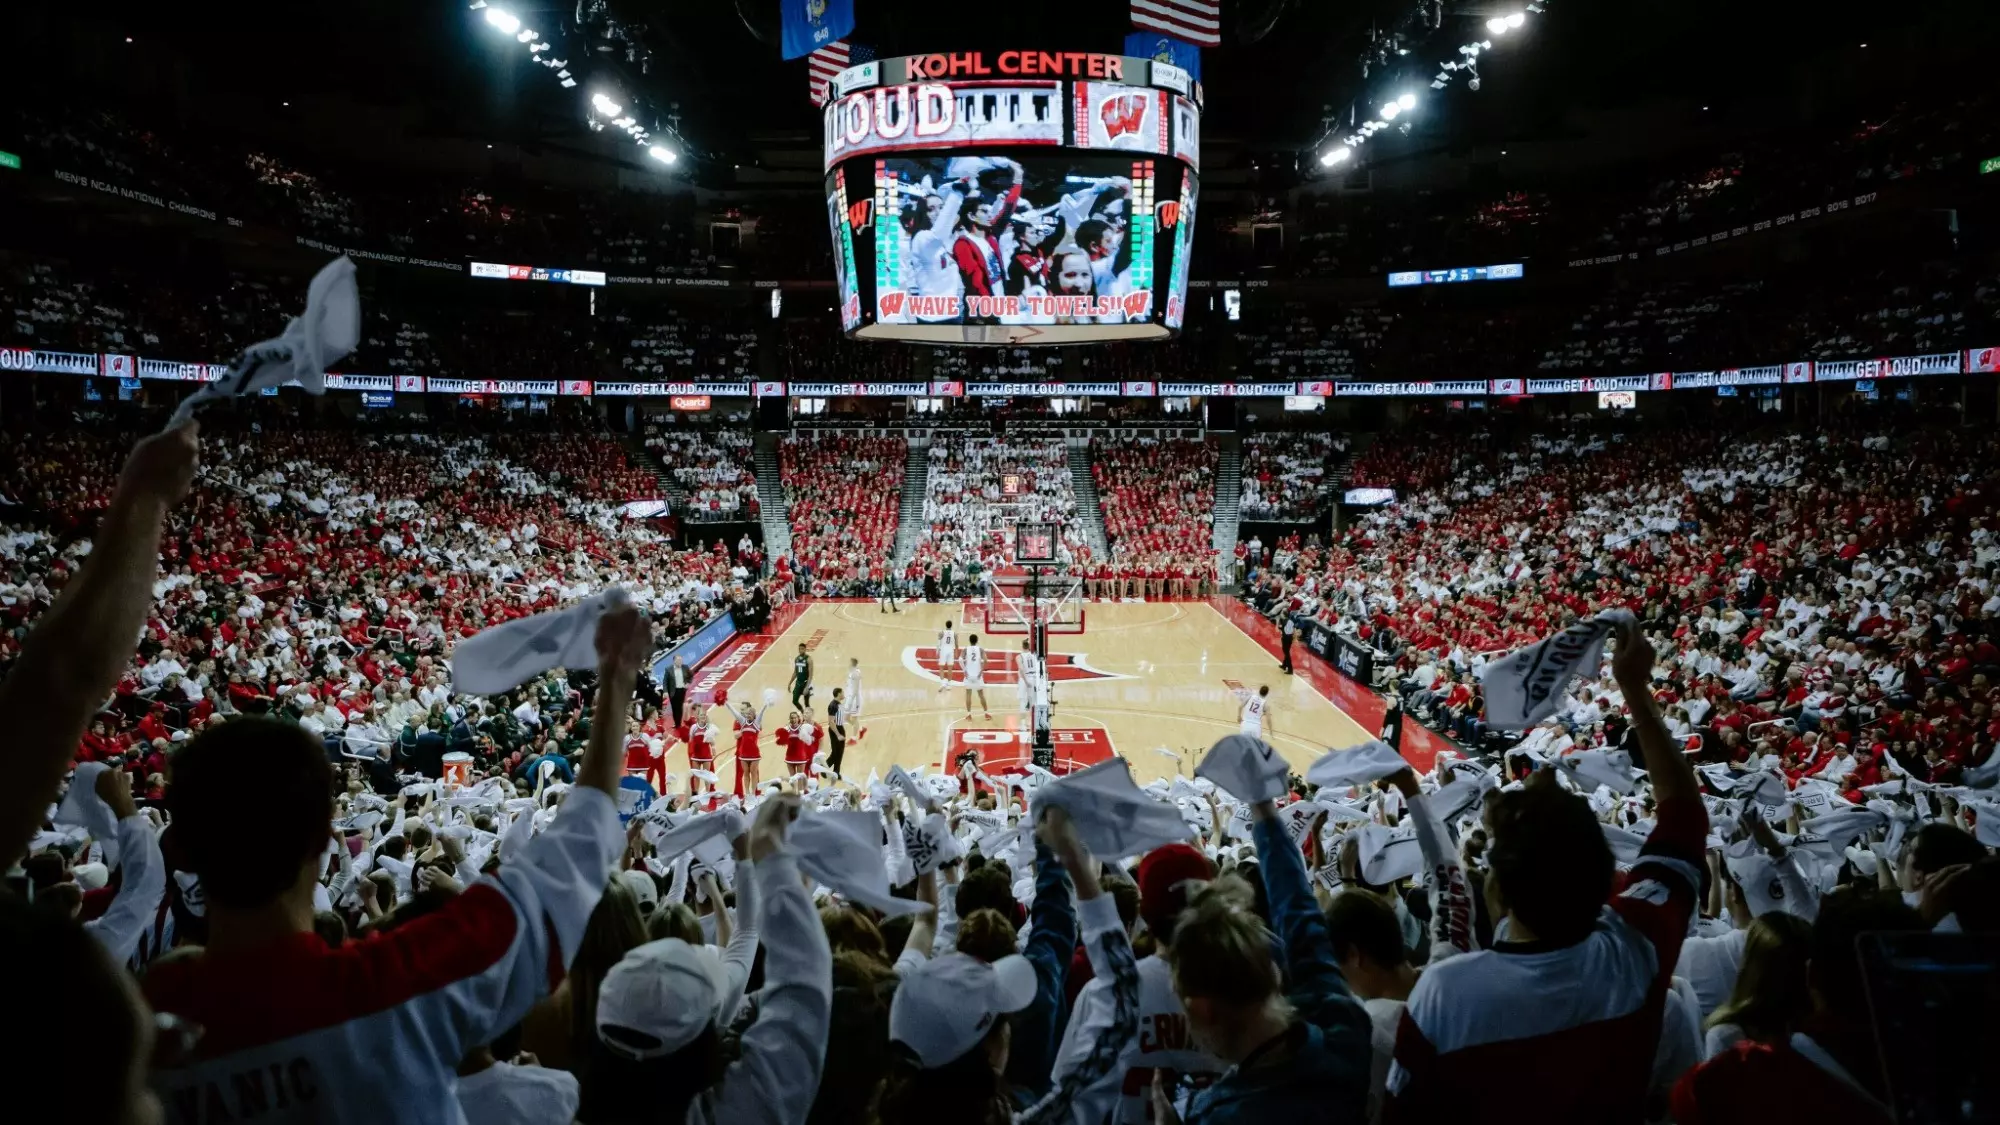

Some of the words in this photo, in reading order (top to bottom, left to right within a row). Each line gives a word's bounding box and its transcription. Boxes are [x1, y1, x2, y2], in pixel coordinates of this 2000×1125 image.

[905, 51, 991, 80] KOHL
[998, 50, 1124, 80] CENTER
[1100, 92, 1148, 142] W
[54, 169, 88, 187] MEN'S
[90, 179, 119, 196] NCAA
[121, 188, 165, 208] NATIONAL
[168, 200, 216, 221] CHAMPIONS
[1776, 213, 1795, 225] 2014
[1855, 192, 1877, 206] 2017
[344, 248, 407, 264] TOURNAMENT
[408, 257, 463, 272] APPEARANCES
[608, 275, 652, 285] WOMEN'S
[656, 277, 671, 285] NIT
[676, 278, 729, 288] CHAMPIONS
[908, 296, 959, 317] WAVE
[966, 296, 1019, 317] YOUR
[1027, 296, 1123, 317] TOWELS!!
[179, 364, 200, 380] GET
[203, 365, 227, 382] LOU
[1856, 361, 1881, 378] GET
[1884, 358, 1921, 376] LOUD
[324, 374, 343, 388] LOUD
[1696, 373, 1714, 386] GET
[1715, 370, 1740, 385] LOUD
[464, 381, 487, 393] GET
[492, 381, 524, 393] LOUD
[633, 383, 657, 395] GET
[662, 383, 695, 395] LOUD
[832, 384, 857, 395] GET
[861, 384, 893, 395] LOUD
[1004, 384, 1028, 395] GET
[1032, 384, 1065, 395] LOUD
[1202, 384, 1226, 396] GET
[1230, 384, 1262, 396] LOUD
[1374, 383, 1398, 394] GET
[1401, 382, 1433, 394] LOUD
[1563, 380, 1583, 392] GET
[1587, 378, 1617, 391] LOUD
[674, 397, 706, 409] Quartz
[971, 652, 977, 661] 2
[1027, 658, 1034, 668] 11
[1249, 702, 1260, 714] 12
